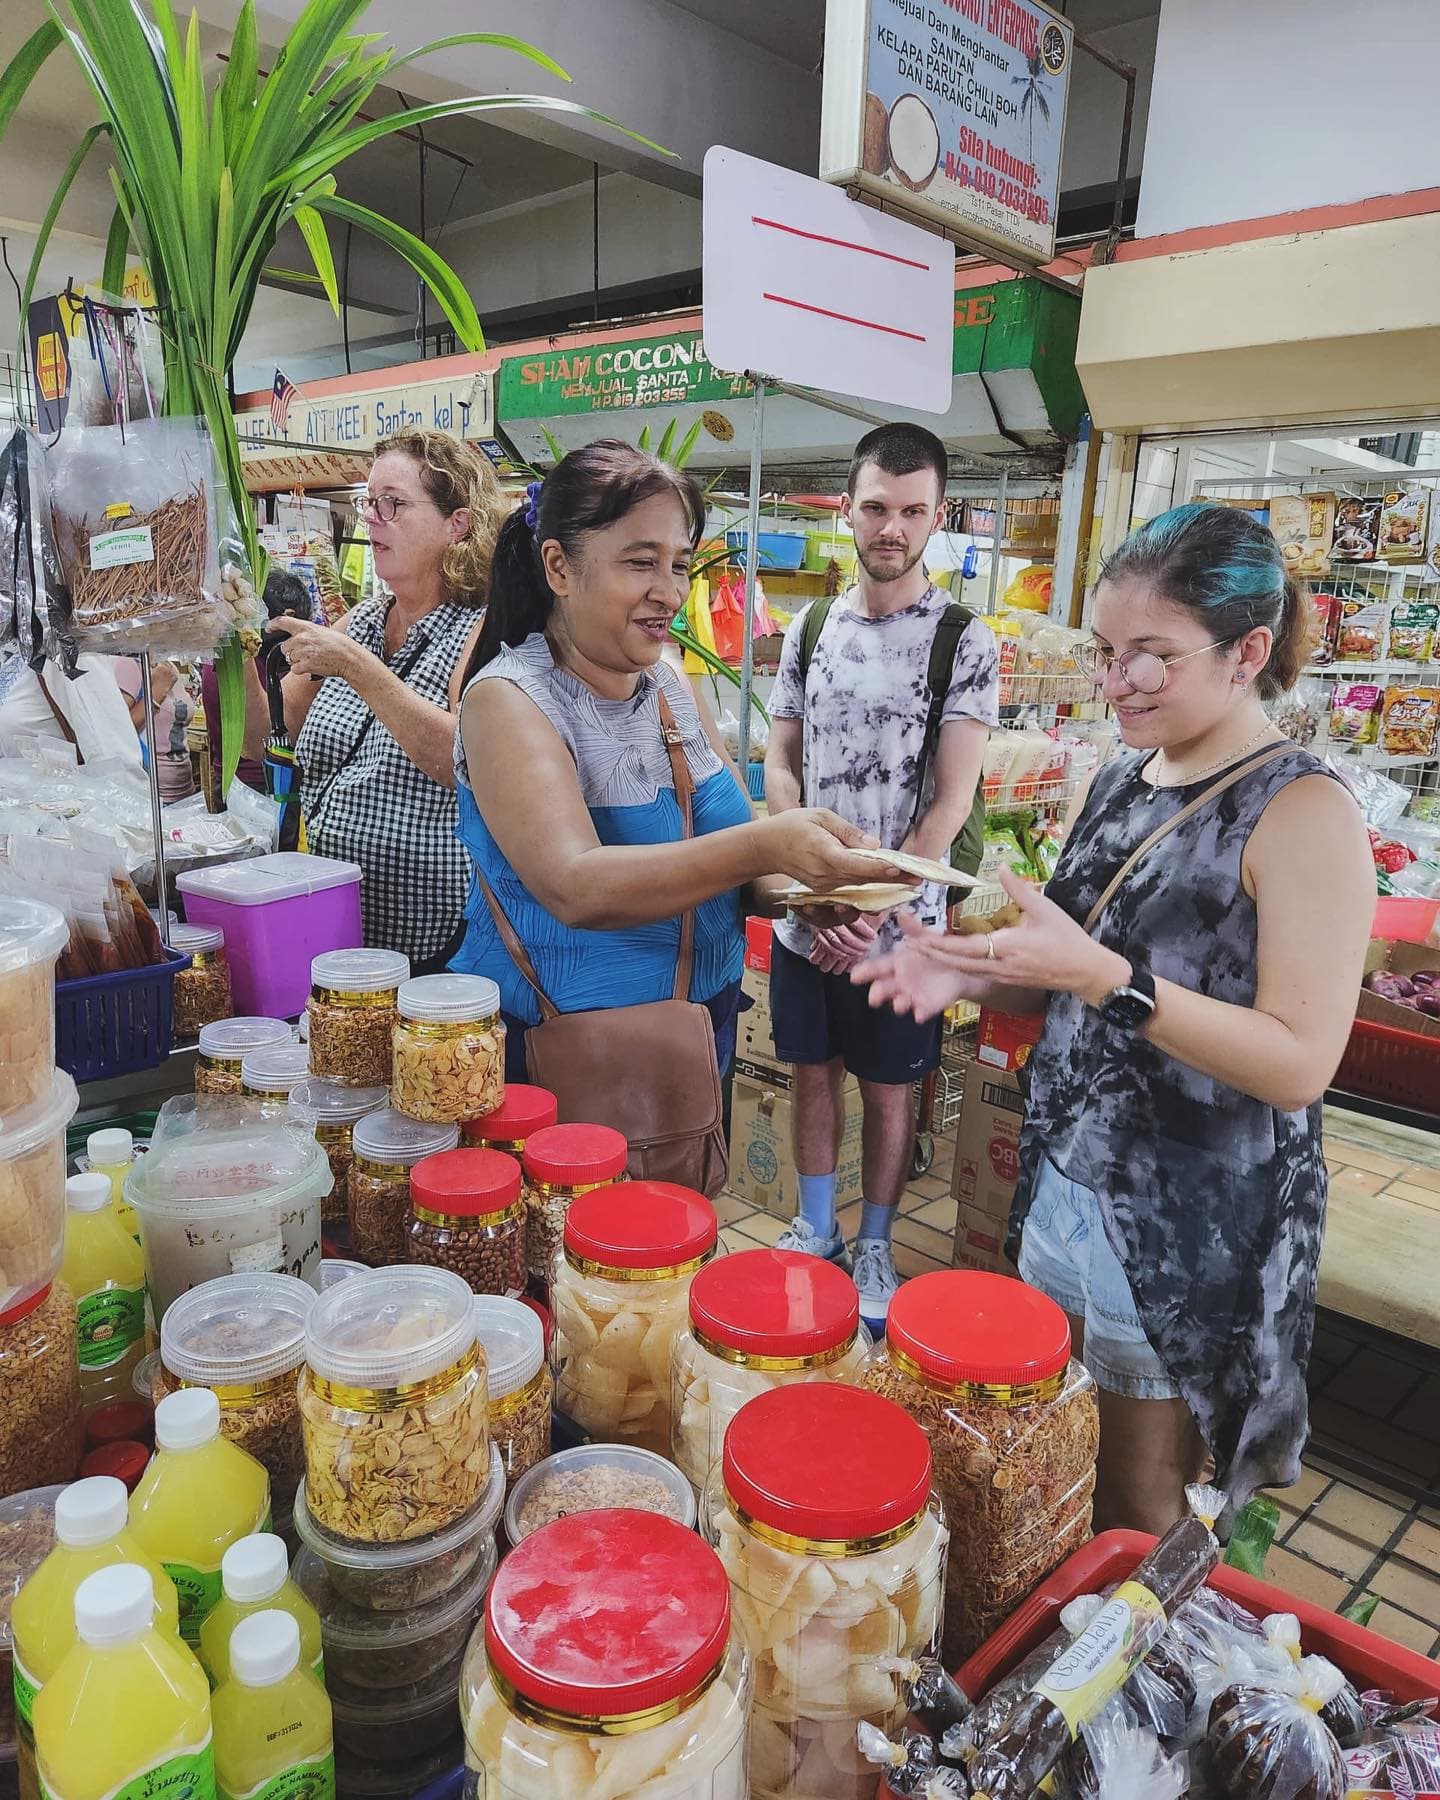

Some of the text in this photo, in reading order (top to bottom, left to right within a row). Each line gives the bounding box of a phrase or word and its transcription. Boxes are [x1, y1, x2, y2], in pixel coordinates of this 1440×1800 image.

[928, 10, 949, 36] Dan
[951, 24, 1010, 74] Menghantar
[930, 37, 975, 76] SANTAN
[877, 25, 1018, 121] KELAPA PARUT, CHILI BOH
[898, 59, 999, 128] DAN BARANG LAIN
[959, 125, 984, 162] Sila
[520, 354, 591, 385] SHAM
[336, 404, 361, 441] KEE
[376, 400, 422, 436] Santan
